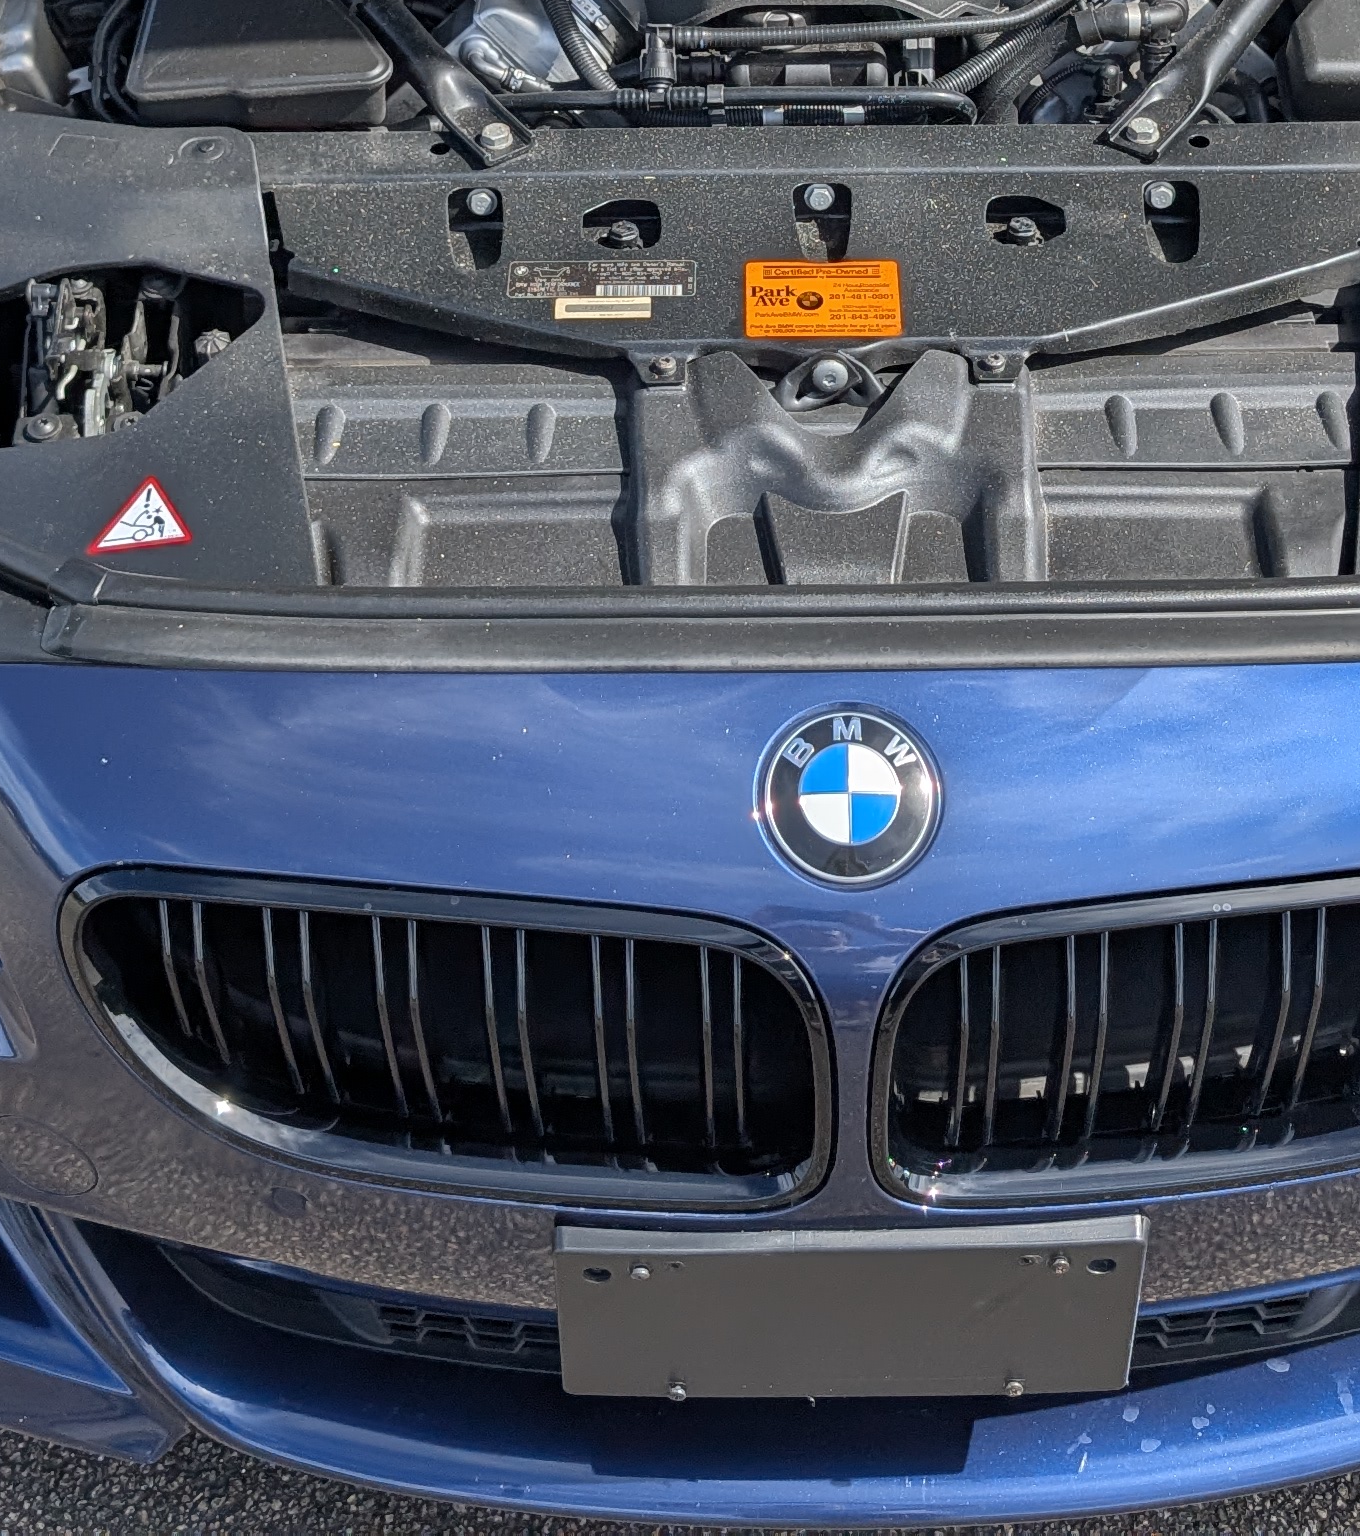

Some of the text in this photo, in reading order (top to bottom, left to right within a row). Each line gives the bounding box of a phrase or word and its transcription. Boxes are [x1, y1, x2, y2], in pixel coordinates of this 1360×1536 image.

[774, 268, 814, 276] Certified
[750, 285, 798, 298] Park
[754, 296, 790, 307] Ave
[782, 716, 917, 768] BMW
